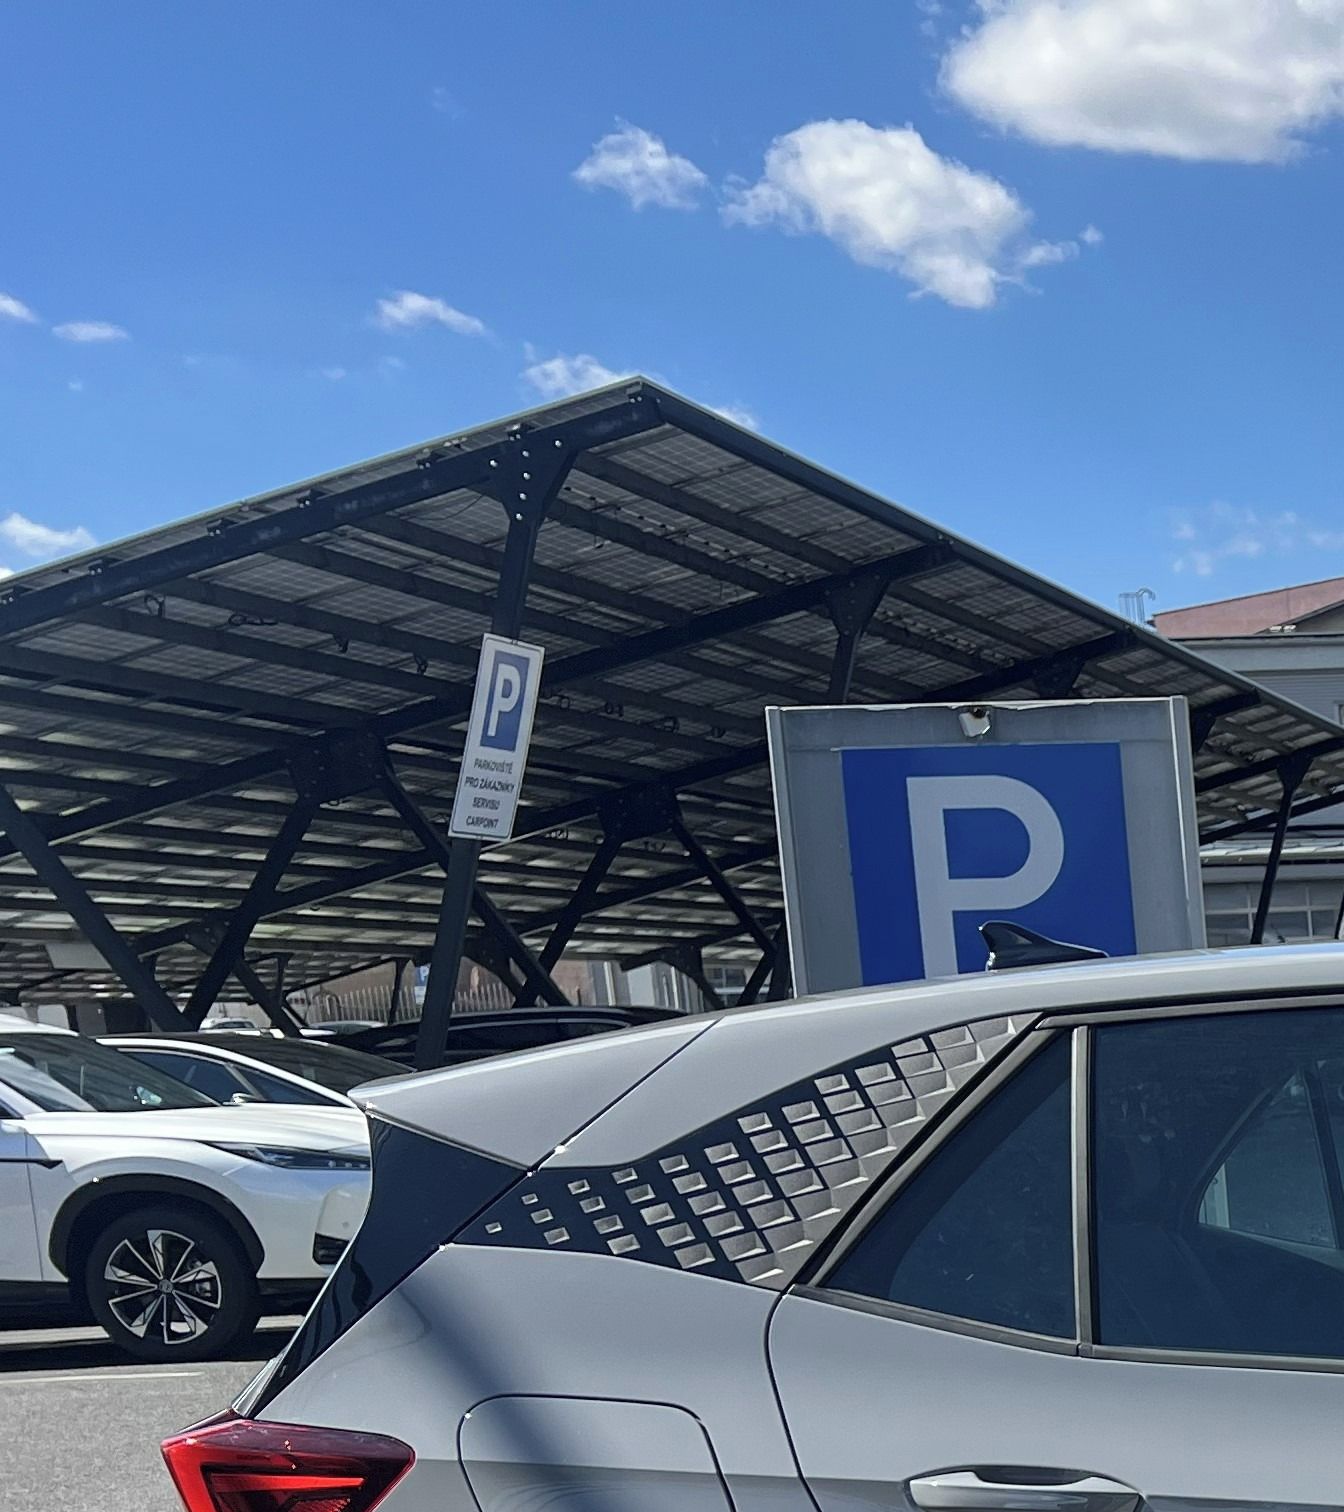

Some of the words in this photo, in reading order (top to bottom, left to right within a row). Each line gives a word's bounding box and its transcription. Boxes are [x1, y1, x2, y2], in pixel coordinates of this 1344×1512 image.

[487, 663, 521, 737] P
[464, 776, 479, 789] PRO
[906, 775, 1064, 979] P
